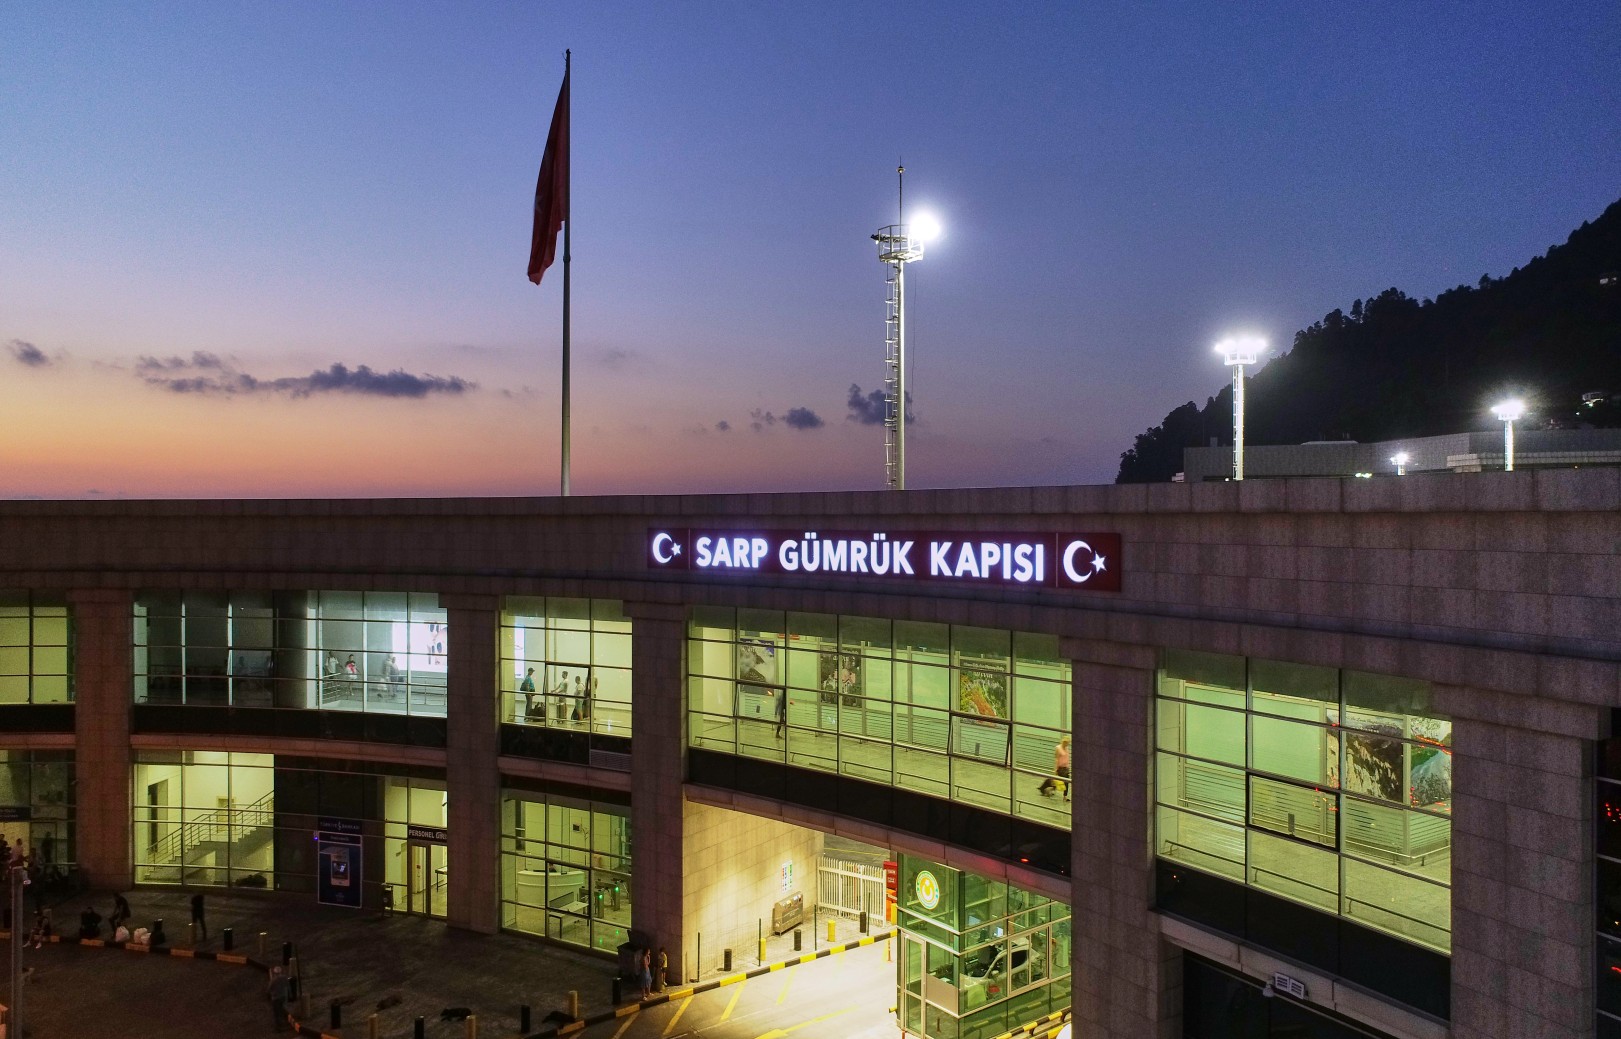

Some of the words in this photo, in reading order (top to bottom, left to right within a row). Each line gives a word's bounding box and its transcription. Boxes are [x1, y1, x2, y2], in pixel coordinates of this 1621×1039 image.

[696, 536, 768, 568] SARP
[778, 532, 915, 575] GÜMRÜK
[930, 541, 1045, 582] KAPISI
